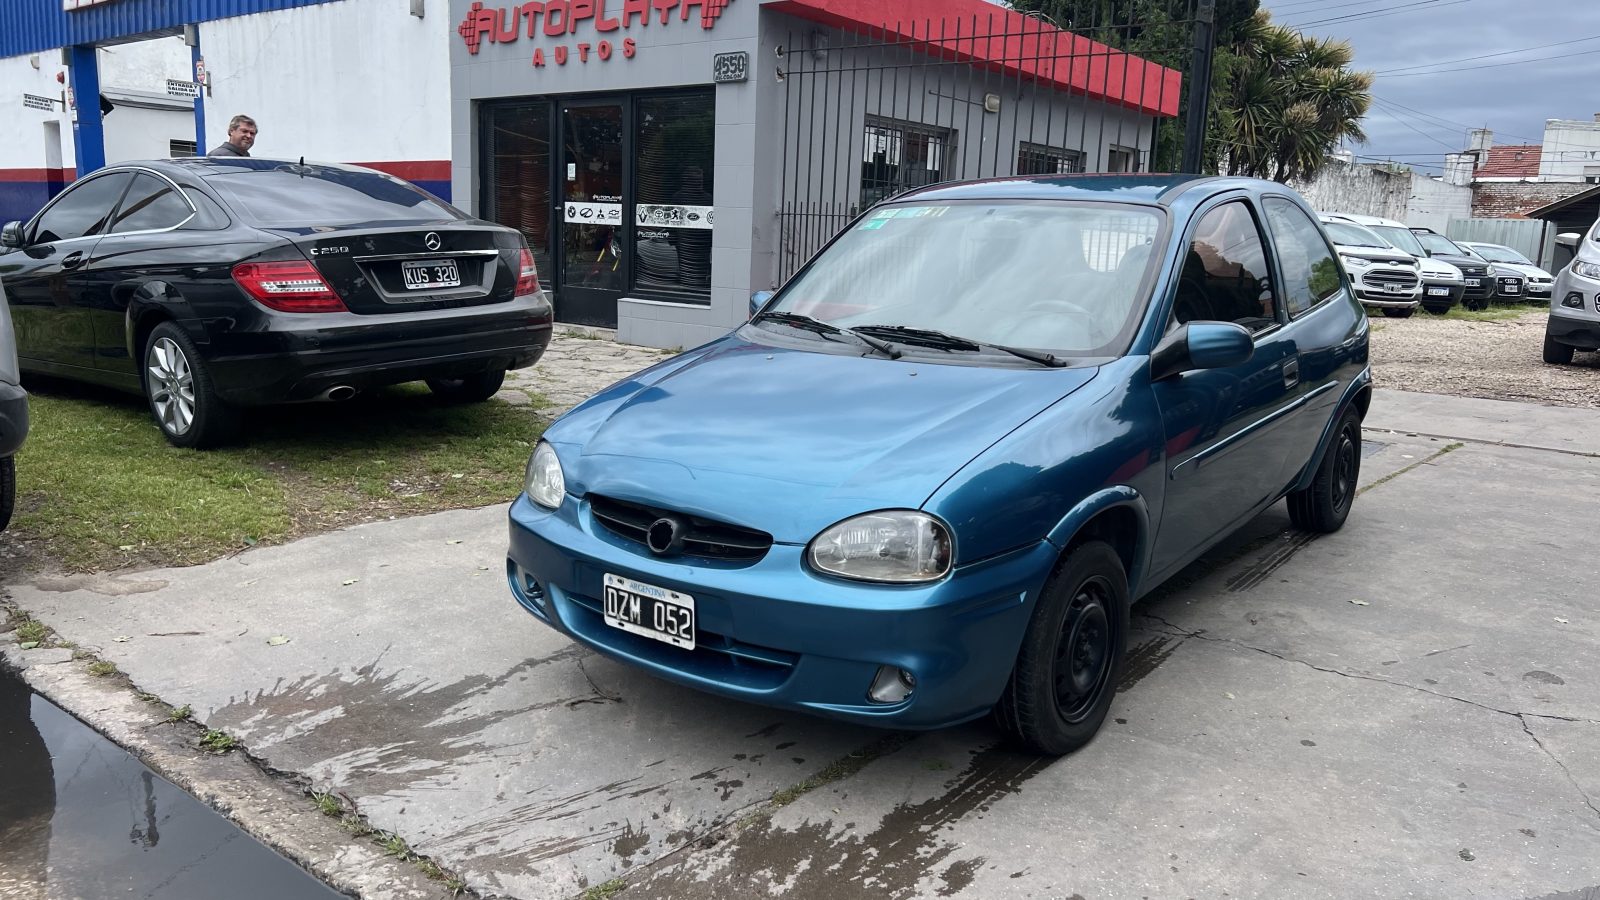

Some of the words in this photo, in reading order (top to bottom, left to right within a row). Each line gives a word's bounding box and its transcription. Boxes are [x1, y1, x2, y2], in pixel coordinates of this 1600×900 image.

[475, 0, 707, 43] AUTOPLAYA
[532, 38, 636, 68] AUTOS
[715, 55, 745, 75] 4550
[321, 246, 350, 255] 250
[405, 268, 430, 284] KUS
[434, 266, 457, 282] 320
[629, 582, 667, 598] ARGENTINA
[607, 588, 642, 625] DZM
[653, 601, 691, 639] 052
